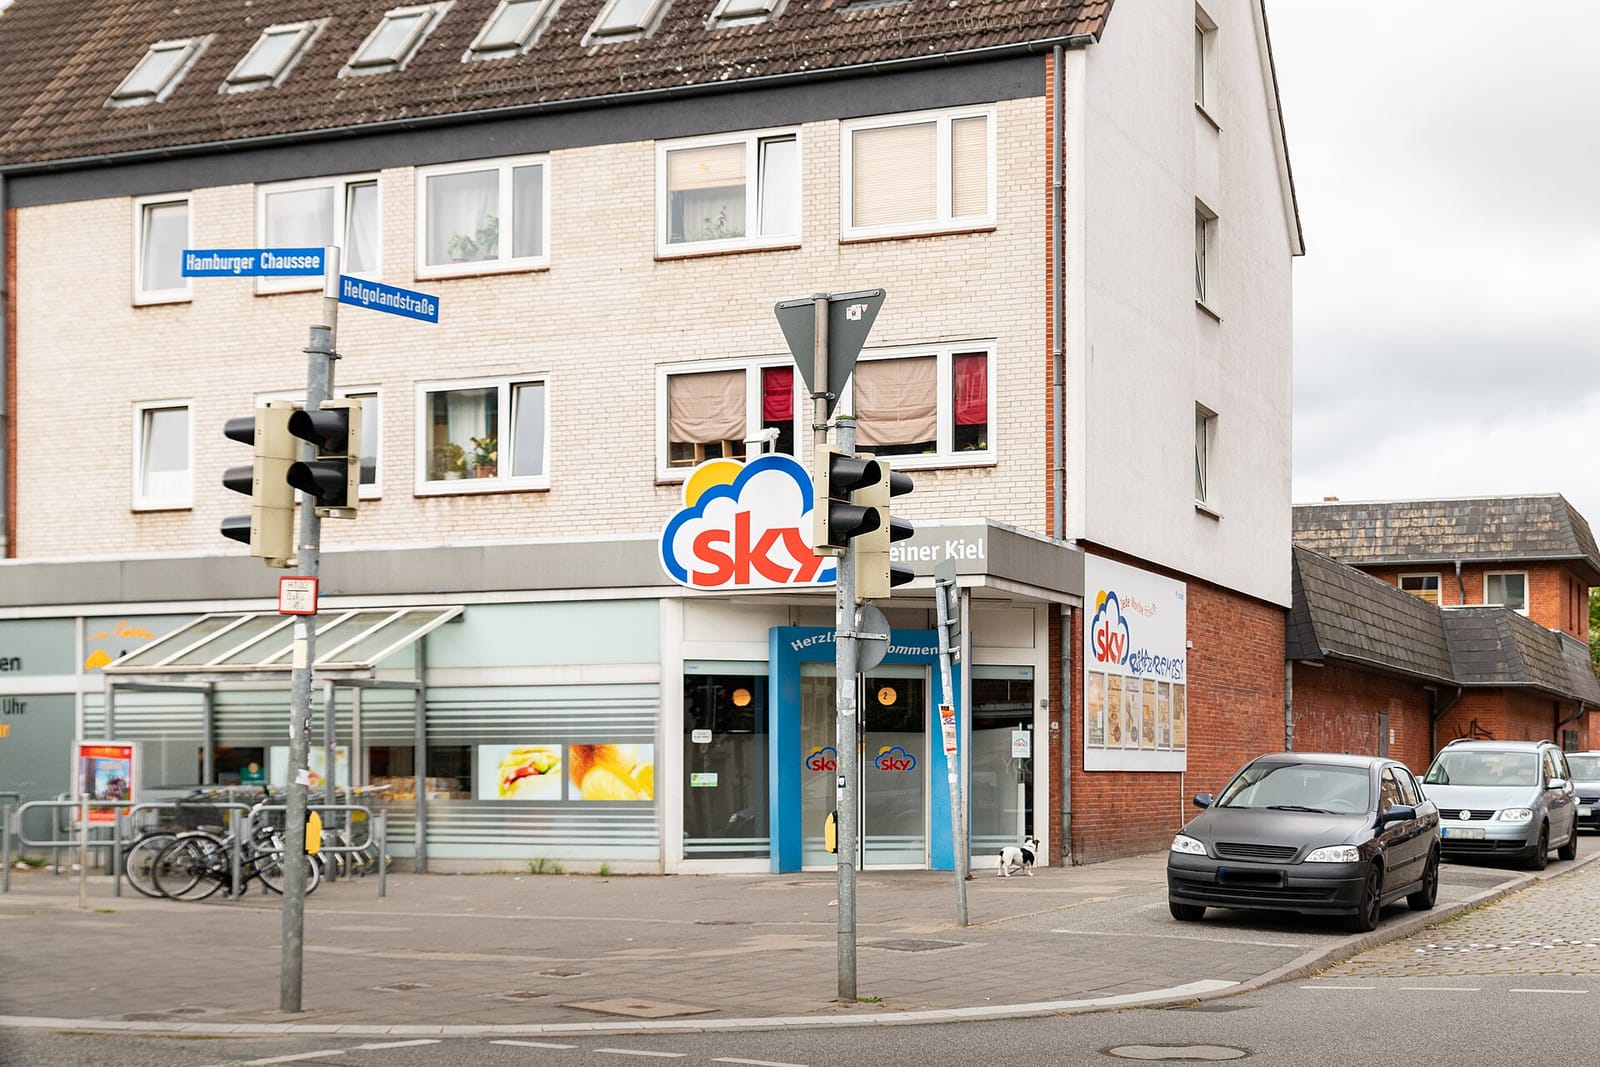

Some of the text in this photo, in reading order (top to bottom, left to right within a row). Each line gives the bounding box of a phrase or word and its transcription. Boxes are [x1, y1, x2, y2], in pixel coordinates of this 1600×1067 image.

[186, 252, 320, 274] Hamburger Chaussee
[344, 279, 435, 317] Helgolandstraße
[692, 510, 825, 587] sky
[889, 537, 985, 562] einer Kiel
[887, 644, 938, 656] ommen
[1097, 620, 1126, 665] sky
[0, 656, 21, 672] en
[3, 697, 27, 715] Uhr
[881, 756, 911, 771] sky
